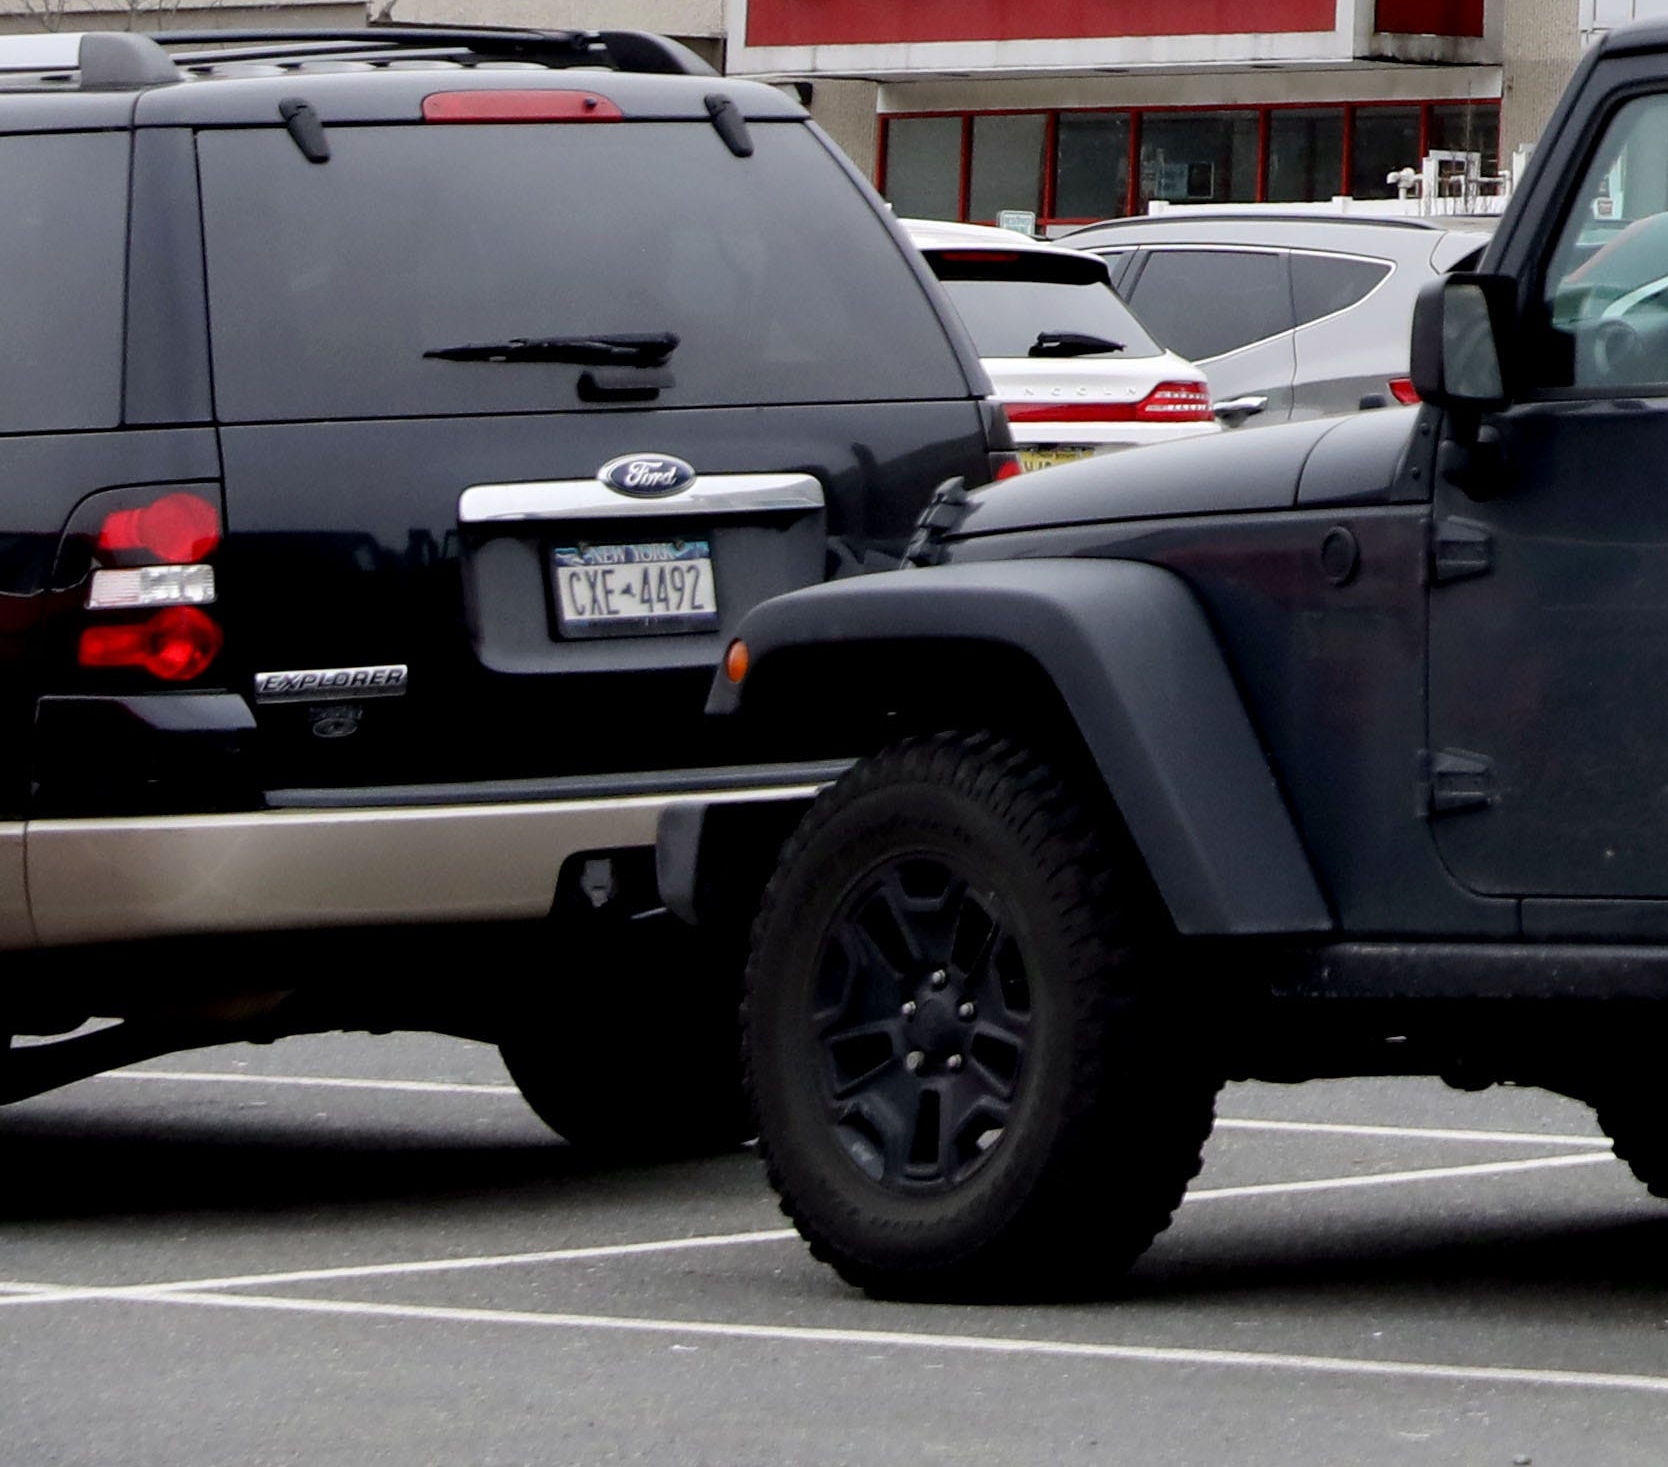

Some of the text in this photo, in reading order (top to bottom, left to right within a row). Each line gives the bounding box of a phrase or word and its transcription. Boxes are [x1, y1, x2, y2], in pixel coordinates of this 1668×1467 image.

[624, 460, 679, 487] Ford
[590, 545, 673, 565] NEW YORK
[261, 669, 405, 693] EXPLORER
